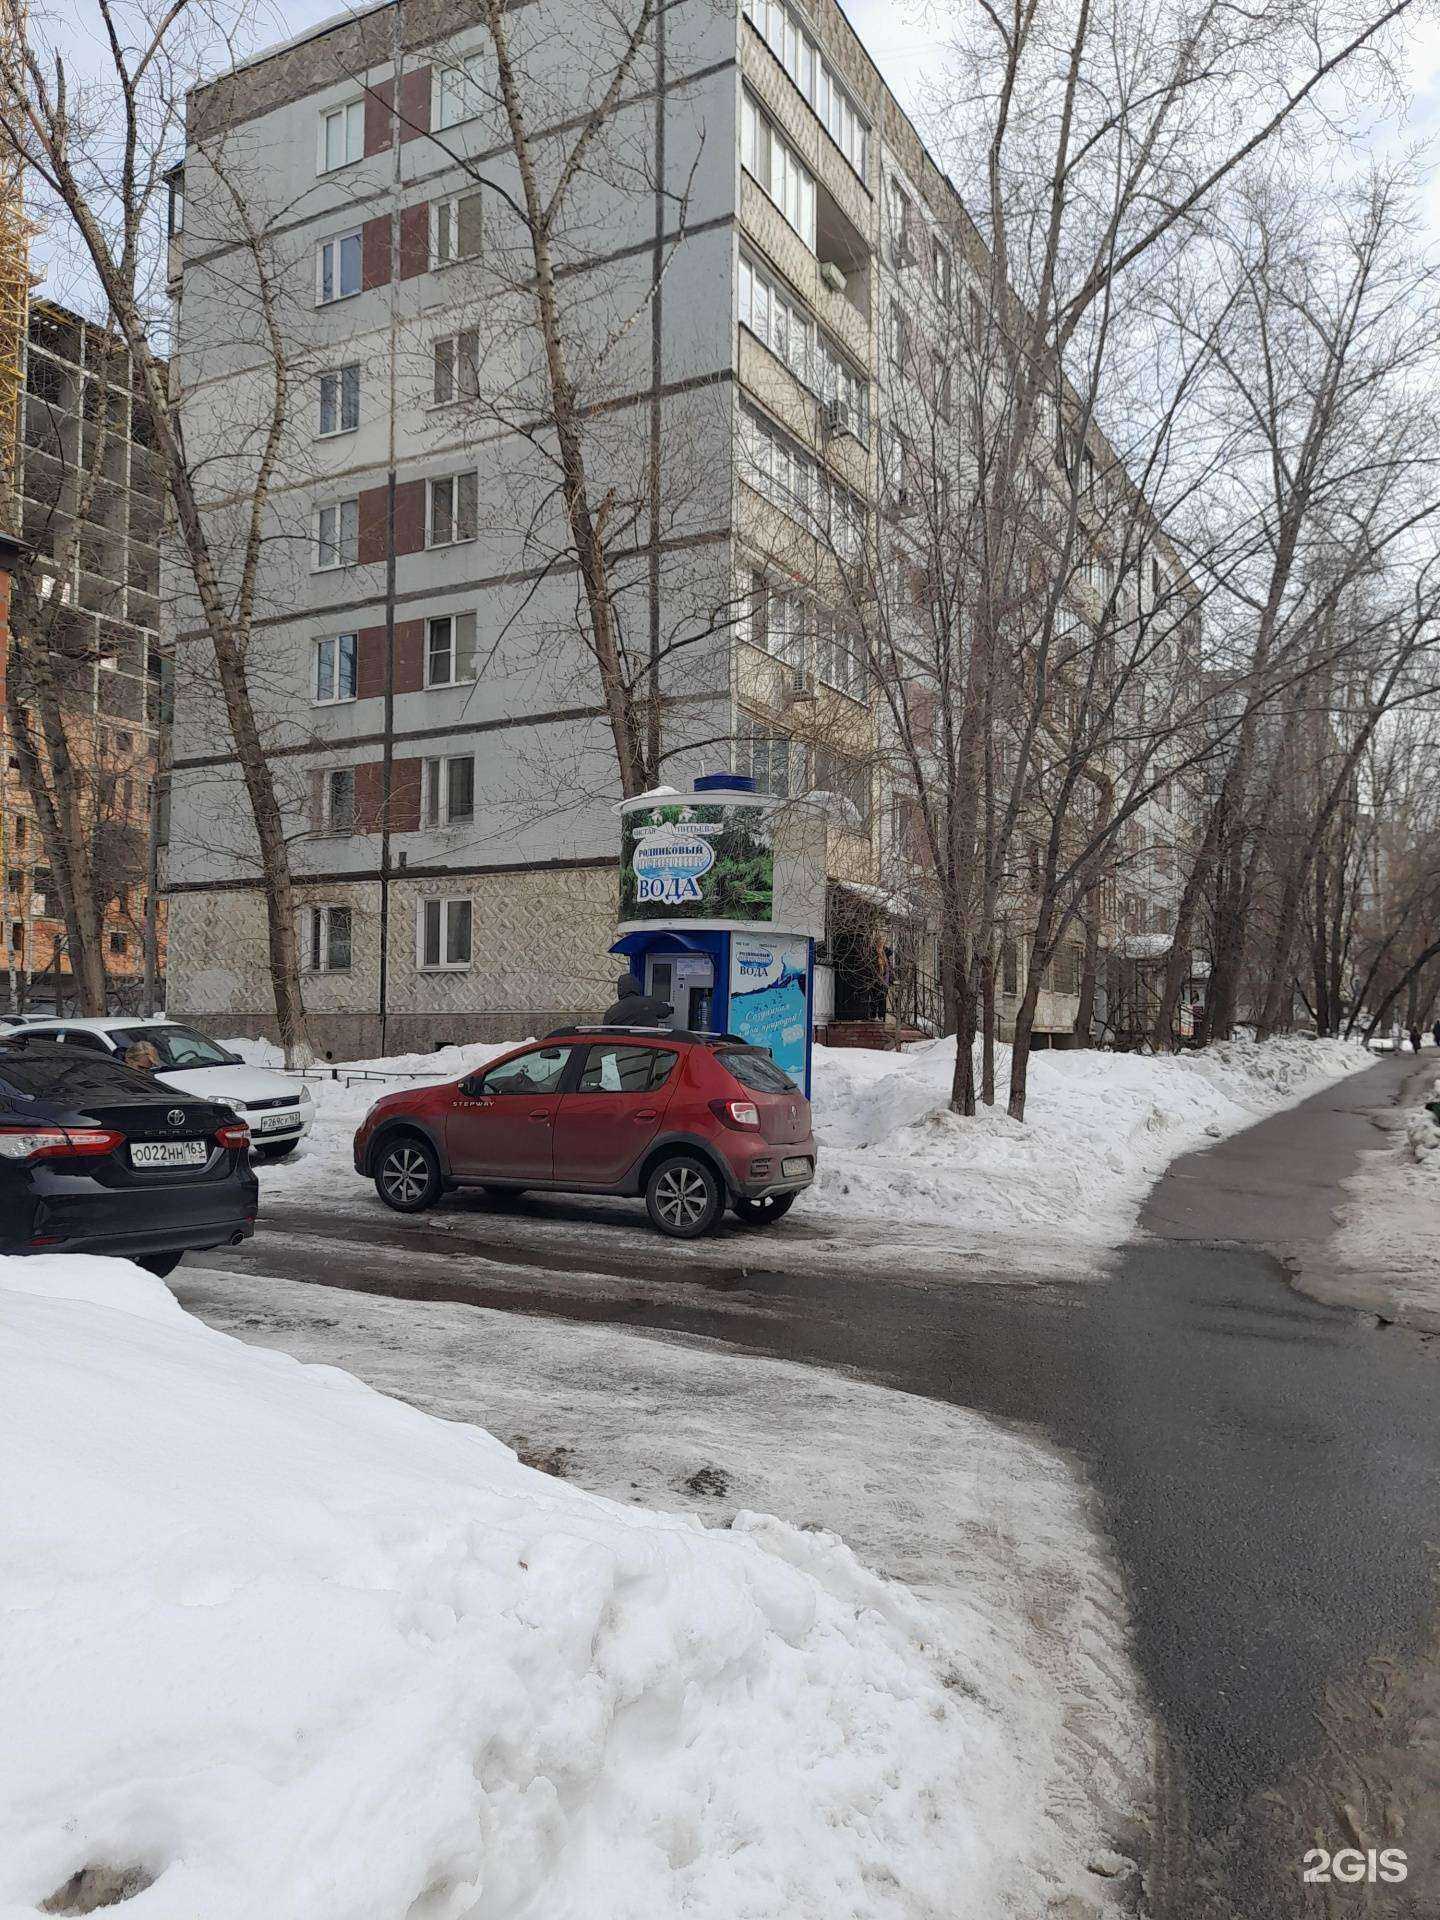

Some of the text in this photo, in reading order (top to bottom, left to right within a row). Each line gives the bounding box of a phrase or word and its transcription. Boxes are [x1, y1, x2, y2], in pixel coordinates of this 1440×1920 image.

[638, 844, 703, 858] РОДНИКОВЫЙ
[640, 877, 698, 900] ВОДА
[740, 967, 769, 977] ВОДА
[185, 1142, 204, 1155] 163
